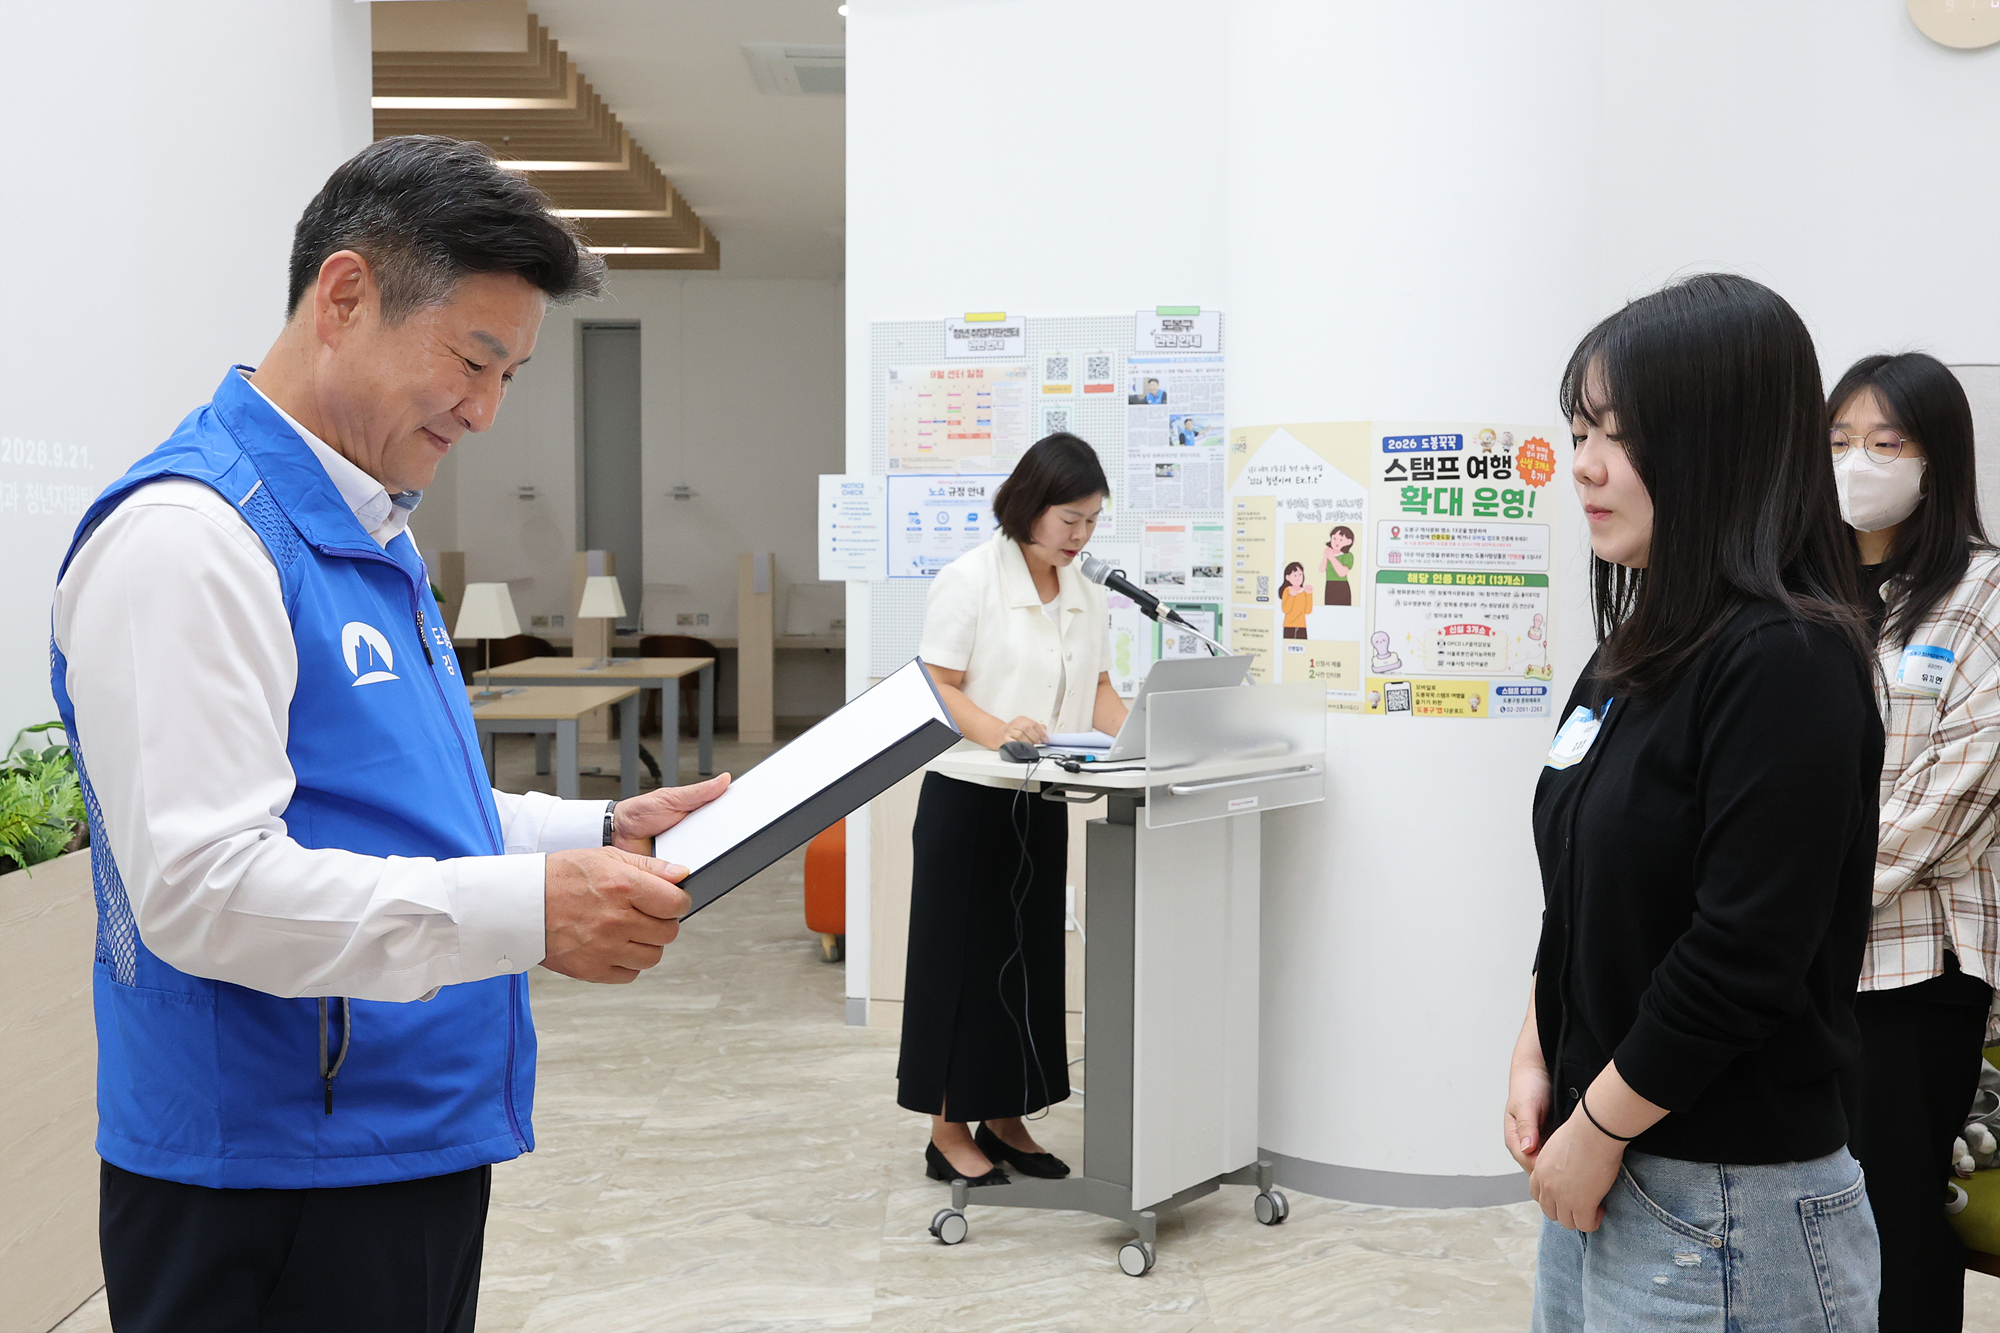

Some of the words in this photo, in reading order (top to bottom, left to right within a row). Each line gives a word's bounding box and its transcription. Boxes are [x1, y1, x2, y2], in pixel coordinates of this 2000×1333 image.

[1162, 319, 1194, 332] 도봉구
[1155, 334, 1178, 348] 관련
[1178, 334, 1202, 348] 안내
[930, 370, 945, 379] 9월
[947, 369, 965, 379] 센터
[967, 369, 984, 378] 일정
[1388, 438, 1417, 450] 2026
[1, 437, 95, 470] 2026.9.21.
[1384, 456, 1461, 482] 스탬프
[1466, 454, 1512, 480] 여행
[1519, 457, 1533, 470] 신설
[1534, 460, 1551, 472] 3개소
[1530, 469, 1547, 482] 추가!
[928, 487, 946, 496] 노쇼
[948, 487, 966, 497] 규정
[967, 486, 985, 497] 안내
[1400, 485, 1464, 516] 확대
[1472, 487, 1536, 519] 운영!
[1407, 572, 1430, 584] 해당
[1432, 573, 1453, 584] 인증
[1456, 573, 1486, 585] 대상지
[1489, 574, 1525, 586] (13개소)
[1449, 625, 1465, 634] 신설
[1466, 625, 1486, 634] 3개소
[1309, 658, 1315, 668] 1
[1309, 669, 1315, 679] 2
[1501, 687, 1519, 695] 스탬프
